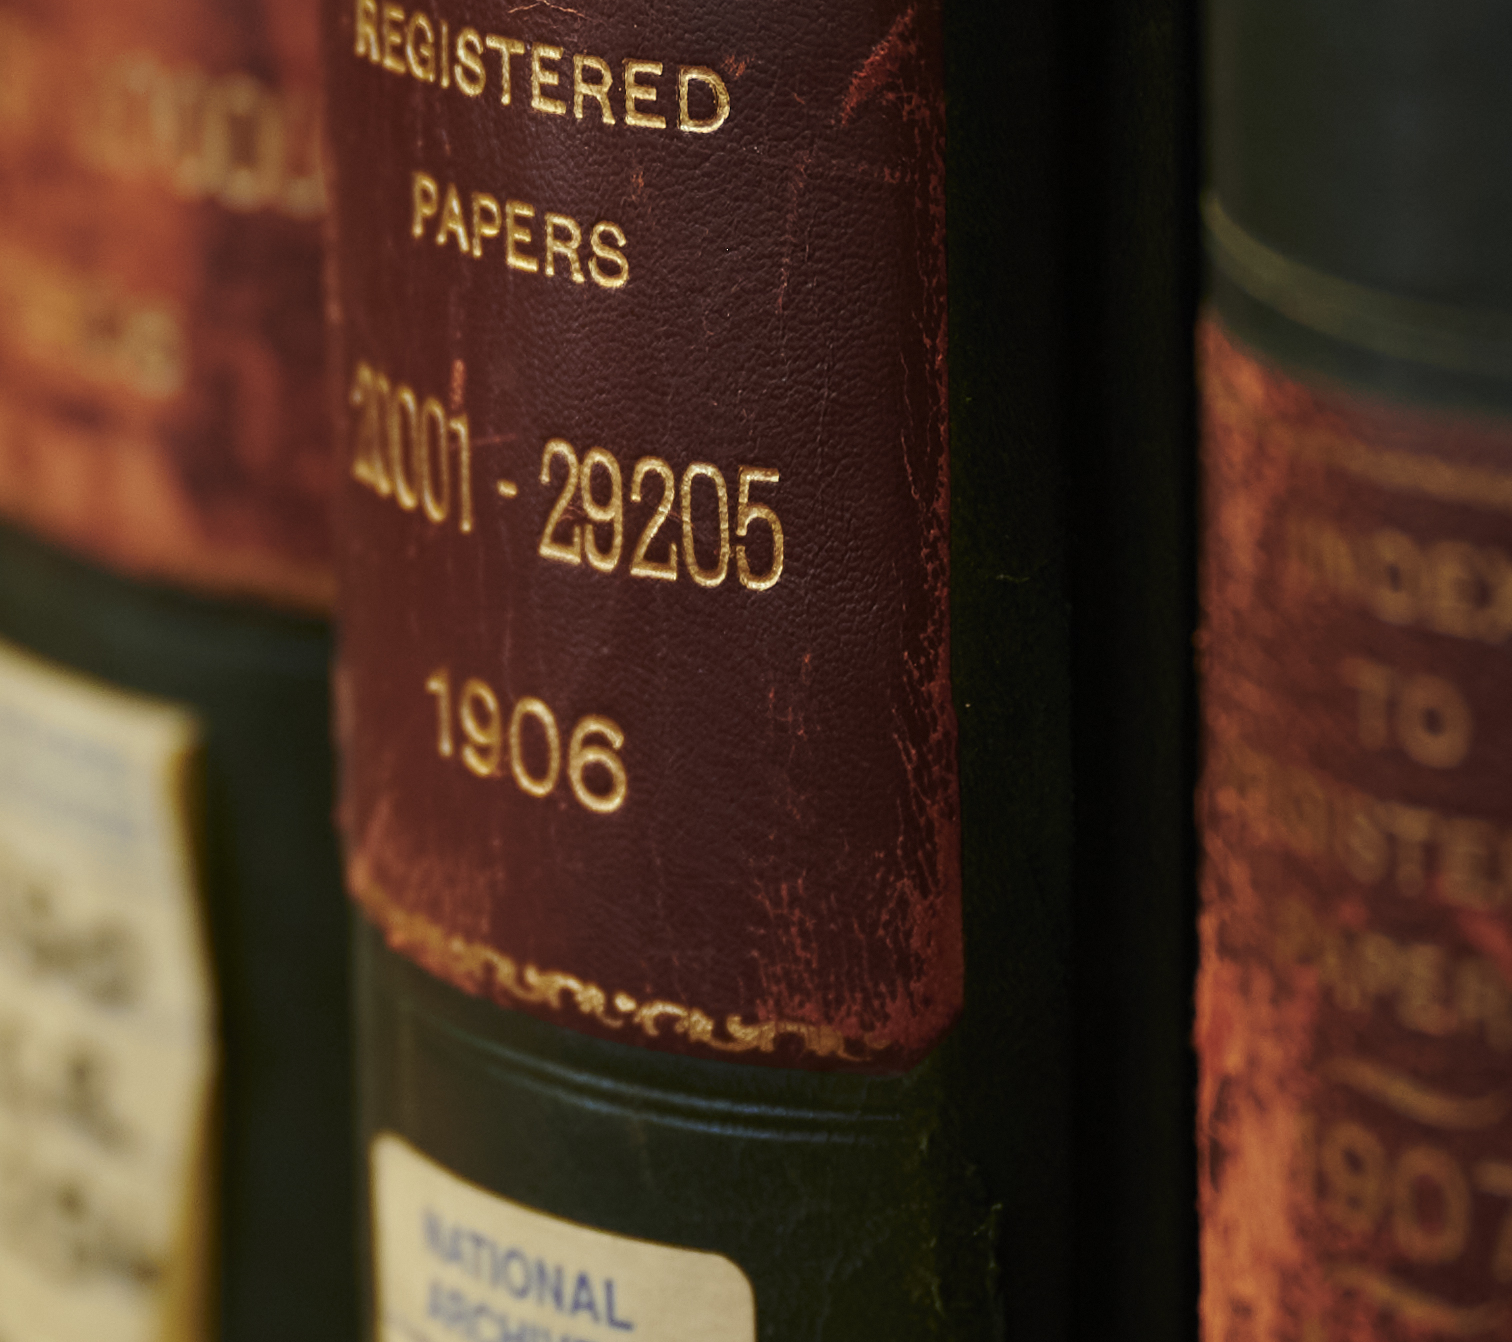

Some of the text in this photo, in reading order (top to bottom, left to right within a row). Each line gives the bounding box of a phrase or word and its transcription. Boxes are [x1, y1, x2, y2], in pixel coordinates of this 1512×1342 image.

[409, 169, 632, 291] PAPERS
[537, 436, 786, 593] 29205
[424, 663, 629, 815] 1906
[1346, 659, 1475, 772] TO
[421, 1209, 636, 1333] NATIONAL
